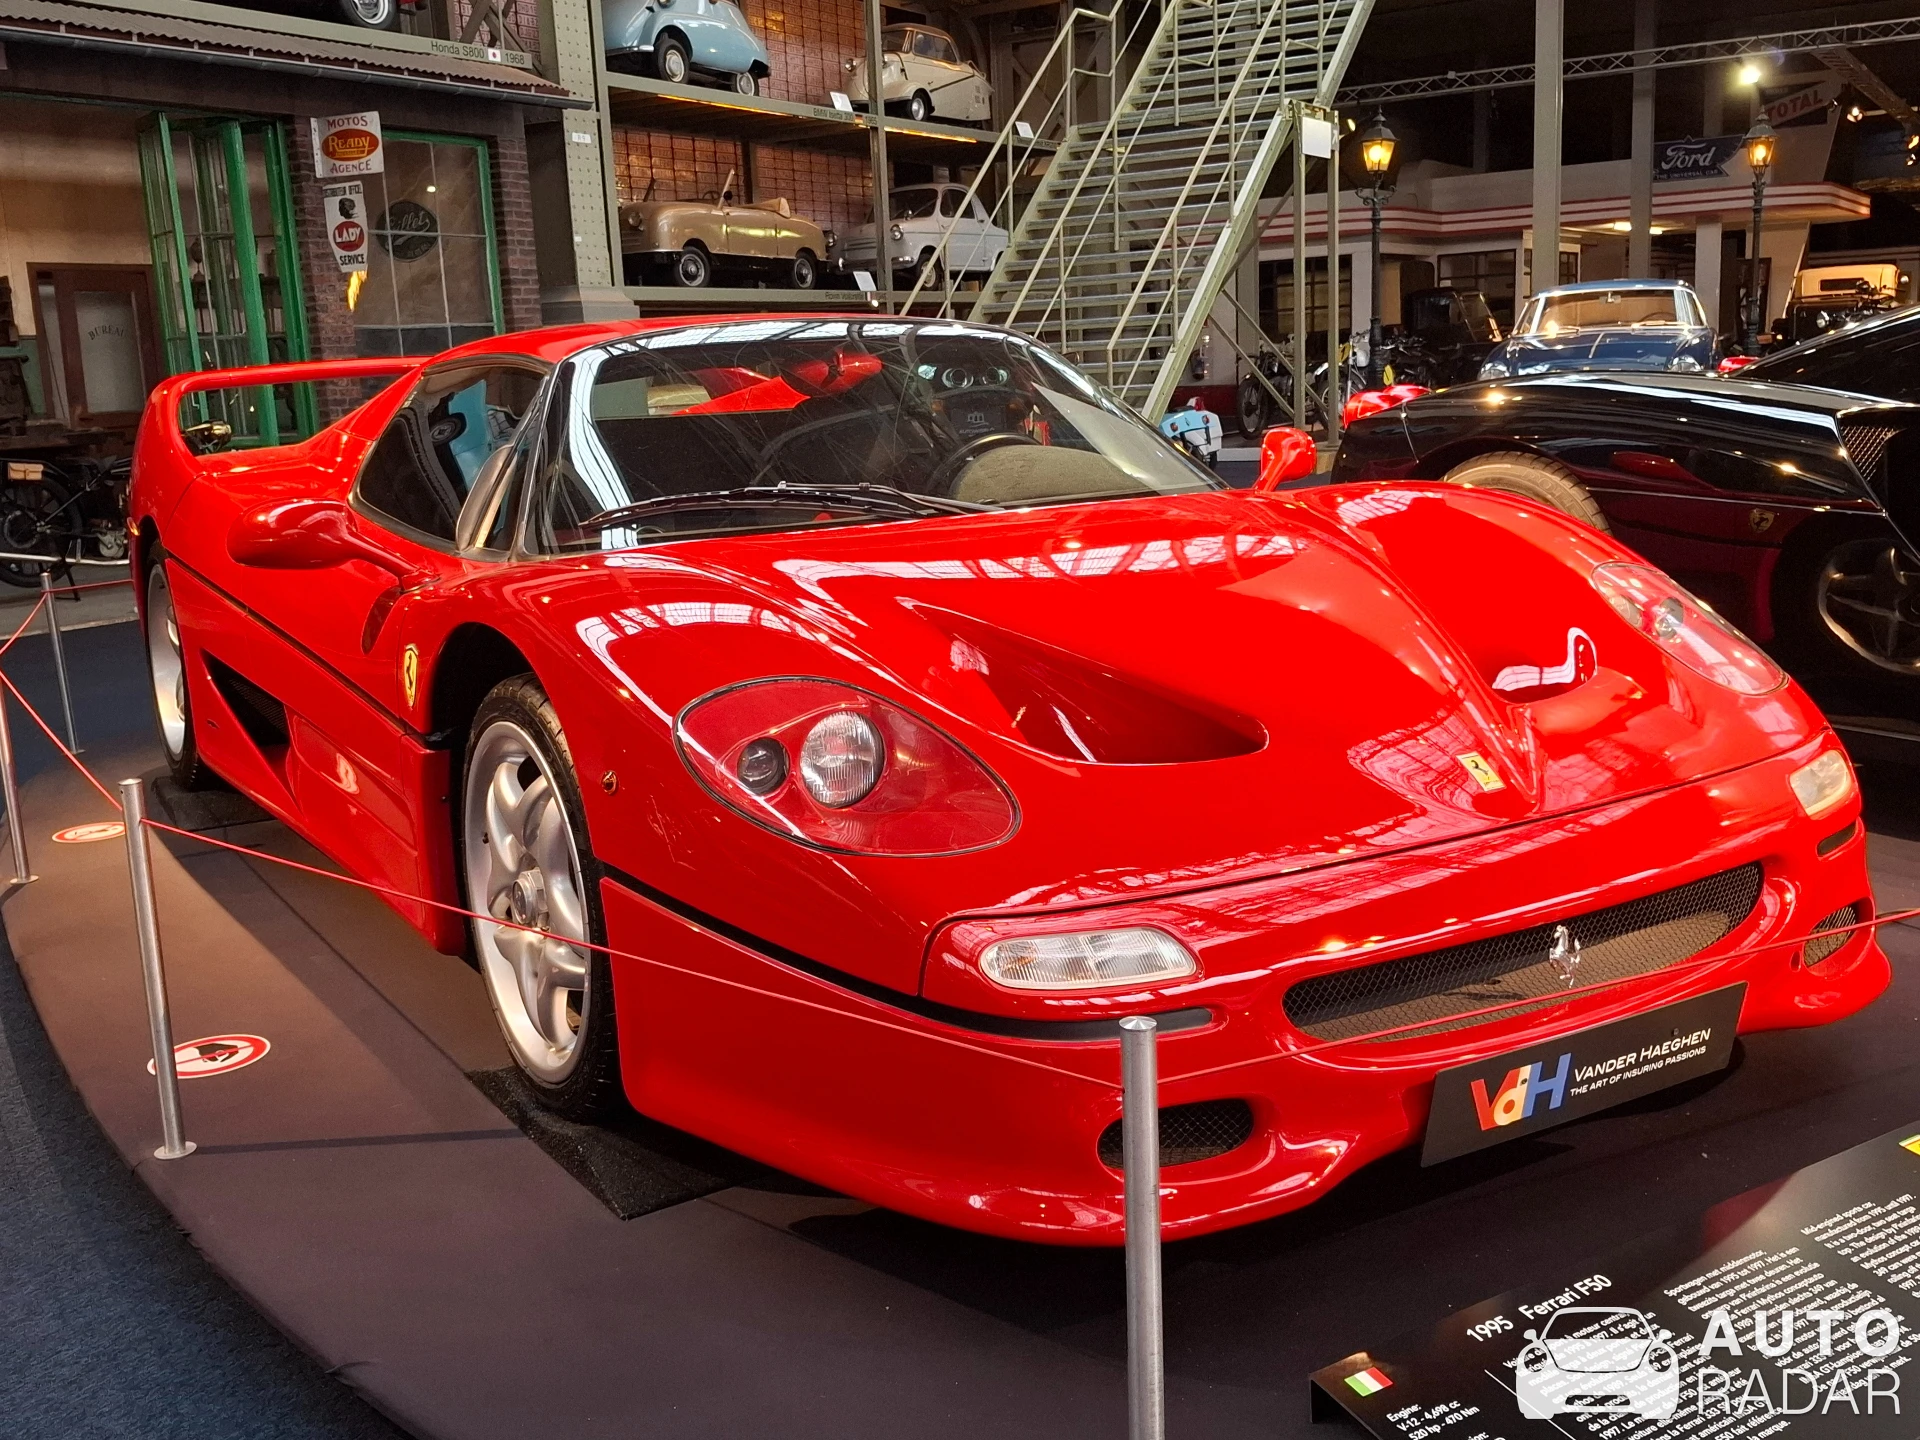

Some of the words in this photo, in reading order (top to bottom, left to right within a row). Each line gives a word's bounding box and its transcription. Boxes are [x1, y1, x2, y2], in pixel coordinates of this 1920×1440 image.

[431, 41, 460, 55] Honda
[462, 46, 484, 59] S800
[505, 53, 525, 65] 1968
[1765, 90, 1824, 120] TOTAL
[327, 116, 368, 130] MOTOS
[328, 135, 370, 153] READY
[330, 159, 372, 174] AGENCE
[1661, 143, 1716, 170] Ford
[335, 227, 361, 243] LADY
[339, 253, 365, 266] SERVICE
[1574, 1052, 1637, 1082] VANDER
[1640, 1028, 1711, 1061] HAEGHEN
[1570, 1084, 1588, 1097] THE
[1589, 1078, 1608, 1091] ART
[1609, 1073, 1622, 1084] OF
[1622, 1060, 1663, 1080] INSURING
[1664, 1046, 1706, 1066] PASSIONS
[1470, 1052, 1571, 1131] VdH
[1814, 1219, 1857, 1241] manufactured
[1852, 1214, 1871, 1223] from
[1867, 1206, 1886, 1216] 1995
[1884, 1200, 1900, 1210] until
[1841, 1206, 1863, 1217] sports
[1842, 1225, 1875, 1240] two-door,
[1871, 1219, 1886, 1227] two
[1884, 1212, 1900, 1221] seat
[1896, 1206, 1916, 1215] targa
[1837, 1247, 1854, 1255] top.
[1848, 1240, 1866, 1248] The
[1863, 1231, 1887, 1243] design
[1859, 1242, 1889, 1258] evolution
[1887, 1237, 1897, 1245] of
[1893, 1233, 1908, 1241] the
[1860, 1256, 1887, 1269] Mythos
[1885, 1244, 1912, 1258] concept
[1872, 1266, 1888, 1276] 349
[1887, 1261, 1902, 1270] cars
[1899, 1254, 1917, 1264] were
[1663, 1275, 1707, 1296] Sportwagen
[1705, 1269, 1722, 1278] met
[1719, 1250, 1766, 1272] middenmotor,
[1677, 1285, 1710, 1305] gebouwd
[1708, 1281, 1723, 1289] van
[1719, 1272, 1739, 1283] 1995
[1736, 1268, 1751, 1276] tot
[1764, 1254, 1781, 1263] Het
[1785, 1246, 1799, 1254] een
[1687, 1296, 1718, 1311] tweezits
[1715, 1288, 1736, 1298] targa
[1733, 1281, 1750, 1290] met
[1746, 1274, 1766, 1284] twee
[1763, 1264, 1790, 1277] deuren.
[1786, 1257, 1803, 1266] Het
[1728, 1297, 1743, 1306] van
[1780, 1273, 1795, 1282] een
[1793, 1262, 1820, 1276] evolutie
[1887, 1271, 1911, 1283] rolling
[1907, 1265, 1918, 1274] off
[1733, 1301, 1760, 1316] Ferrari
[1756, 1292, 1785, 1305] Mythos
[1783, 1273, 1824, 1293] conceptauto
[1788, 1291, 1813, 1305] slechts
[1808, 1284, 1824, 1294] 349
[1823, 1279, 1837, 1288] van
[1823, 1286, 1851, 1300] waarbij
[1466, 1315, 1513, 1341] 1995
[1518, 1288, 1580, 1319] Ferrari
[1573, 1274, 1611, 1295] F50
[1793, 1330, 1817, 1343] motor
[1847, 1298, 1879, 1315] bestond
[1876, 1294, 1885, 1302] al
[1572, 1323, 1600, 1338] moteur
[1666, 1332, 1694, 1348] Ferrari
[1791, 1351, 1804, 1359] de
[1833, 1341, 1852, 1351] voor
[1897, 1339, 1912, 1347] de
[1732, 1377, 1751, 1388] été
[1386, 1404, 1421, 1421] Engine:
[1588, 1422, 1601, 1431] de
[1685, 1375, 1698, 1383] en
[1620, 1421, 1635, 1429] Le
[1677, 1388, 1699, 1400] F50
[1396, 1417, 1420, 1431] V-12
[1424, 1404, 1449, 1419] 4,698
[1448, 1400, 1460, 1409] cc
[1408, 1428, 1428, 1440] 520
[1424, 1424, 1441, 1433] hp
[1445, 1412, 1463, 1424] 470
[1459, 1406, 1479, 1417] Nm
[1576, 1410, 1592, 1422] ont
[1675, 1414, 1705, 1432] Ferrari
[1700, 1407, 1720, 1419] 333
[1698, 1416, 1736, 1437] américain
[1730, 1424, 1749, 1435] fait
[1757, 1420, 1791, 1439] marque.
